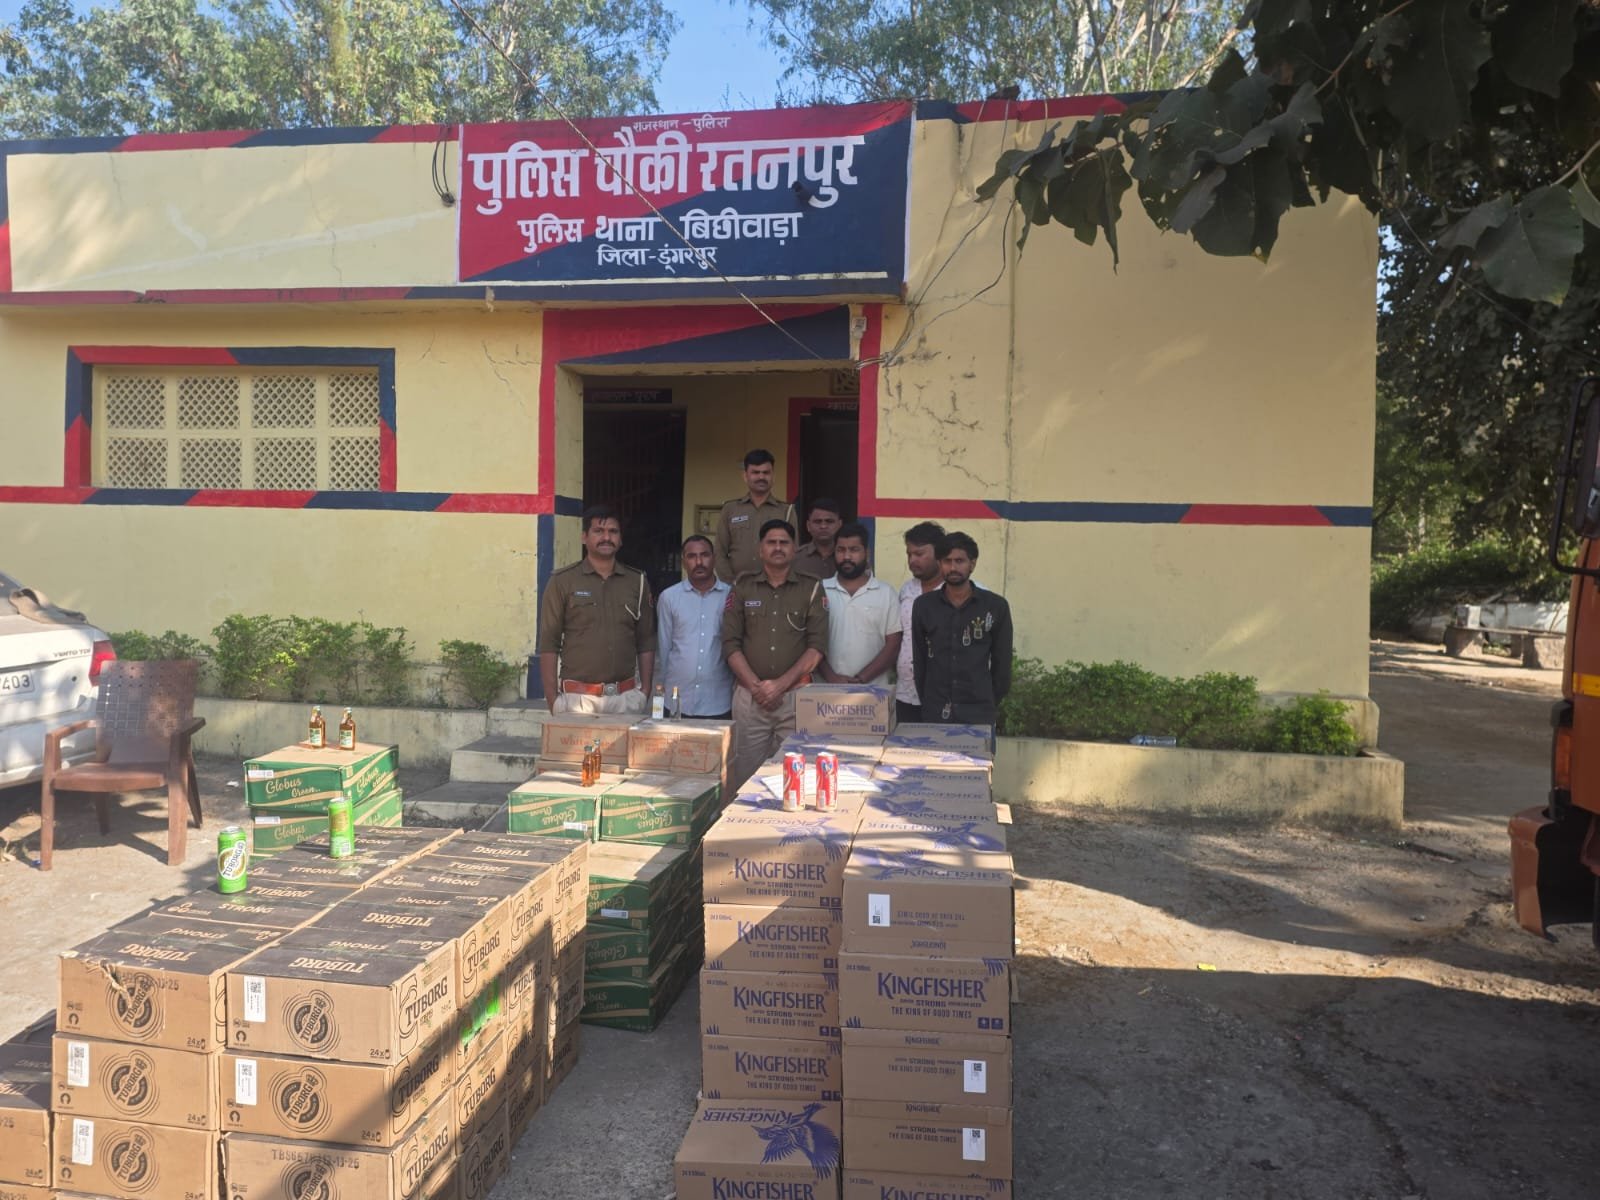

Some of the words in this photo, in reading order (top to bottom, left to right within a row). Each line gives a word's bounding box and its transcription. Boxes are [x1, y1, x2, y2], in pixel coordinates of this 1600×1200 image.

[468, 140, 588, 215] पुलिस
[595, 127, 691, 196] चौकी
[698, 136, 865, 208] रतनपुर
[517, 212, 584, 253] पुलिस
[595, 215, 662, 242] थाना
[679, 207, 803, 246] बिछीवाड़ा
[0, 674, 30, 690] 403
[816, 702, 876, 717] KINGFISHER
[265, 776, 302, 794] Globus
[223, 848, 243, 876] TUBORG
[472, 846, 532, 857] TUBORG
[449, 861, 511, 873] TUBORG
[735, 858, 827, 883] KINGFISHER
[902, 866, 1003, 880] KINGFISHER
[246, 886, 314, 898] TUBORG
[428, 875, 480, 887] STRONG
[558, 868, 581, 896] TUBORG
[218, 903, 275, 914] STRONG
[362, 912, 436, 927] TUBORG
[517, 898, 543, 931] TUBORG
[737, 920, 831, 945] KINGFISHER
[119, 943, 197, 962] TUBORG
[467, 931, 500, 973] TUBORG
[288, 957, 368, 974] TUBORG
[733, 986, 826, 1013] KINGFISHER
[877, 972, 986, 1002] KINGFISHER
[123, 989, 147, 1025] TUBORG
[406, 976, 448, 1027] TUBORG
[891, 1007, 903, 1015] THE
[905, 1008, 921, 1016] KING
[952, 1010, 972, 1019] TIMES
[300, 1005, 322, 1041] TUBORG
[735, 1051, 829, 1077] KINGFISHER
[117, 1066, 142, 1102] TUBORG
[399, 1054, 439, 1106] TUBORG
[464, 1068, 496, 1118] TUBORG
[287, 1081, 313, 1120] TUBORG
[703, 1110, 793, 1124] KINGFISHER
[117, 1143, 142, 1180] TUBORG
[407, 1127, 449, 1188] TUBORG
[300, 1170, 322, 1200] UBORG
[712, 1177, 816, 1200] KINGFISHER
